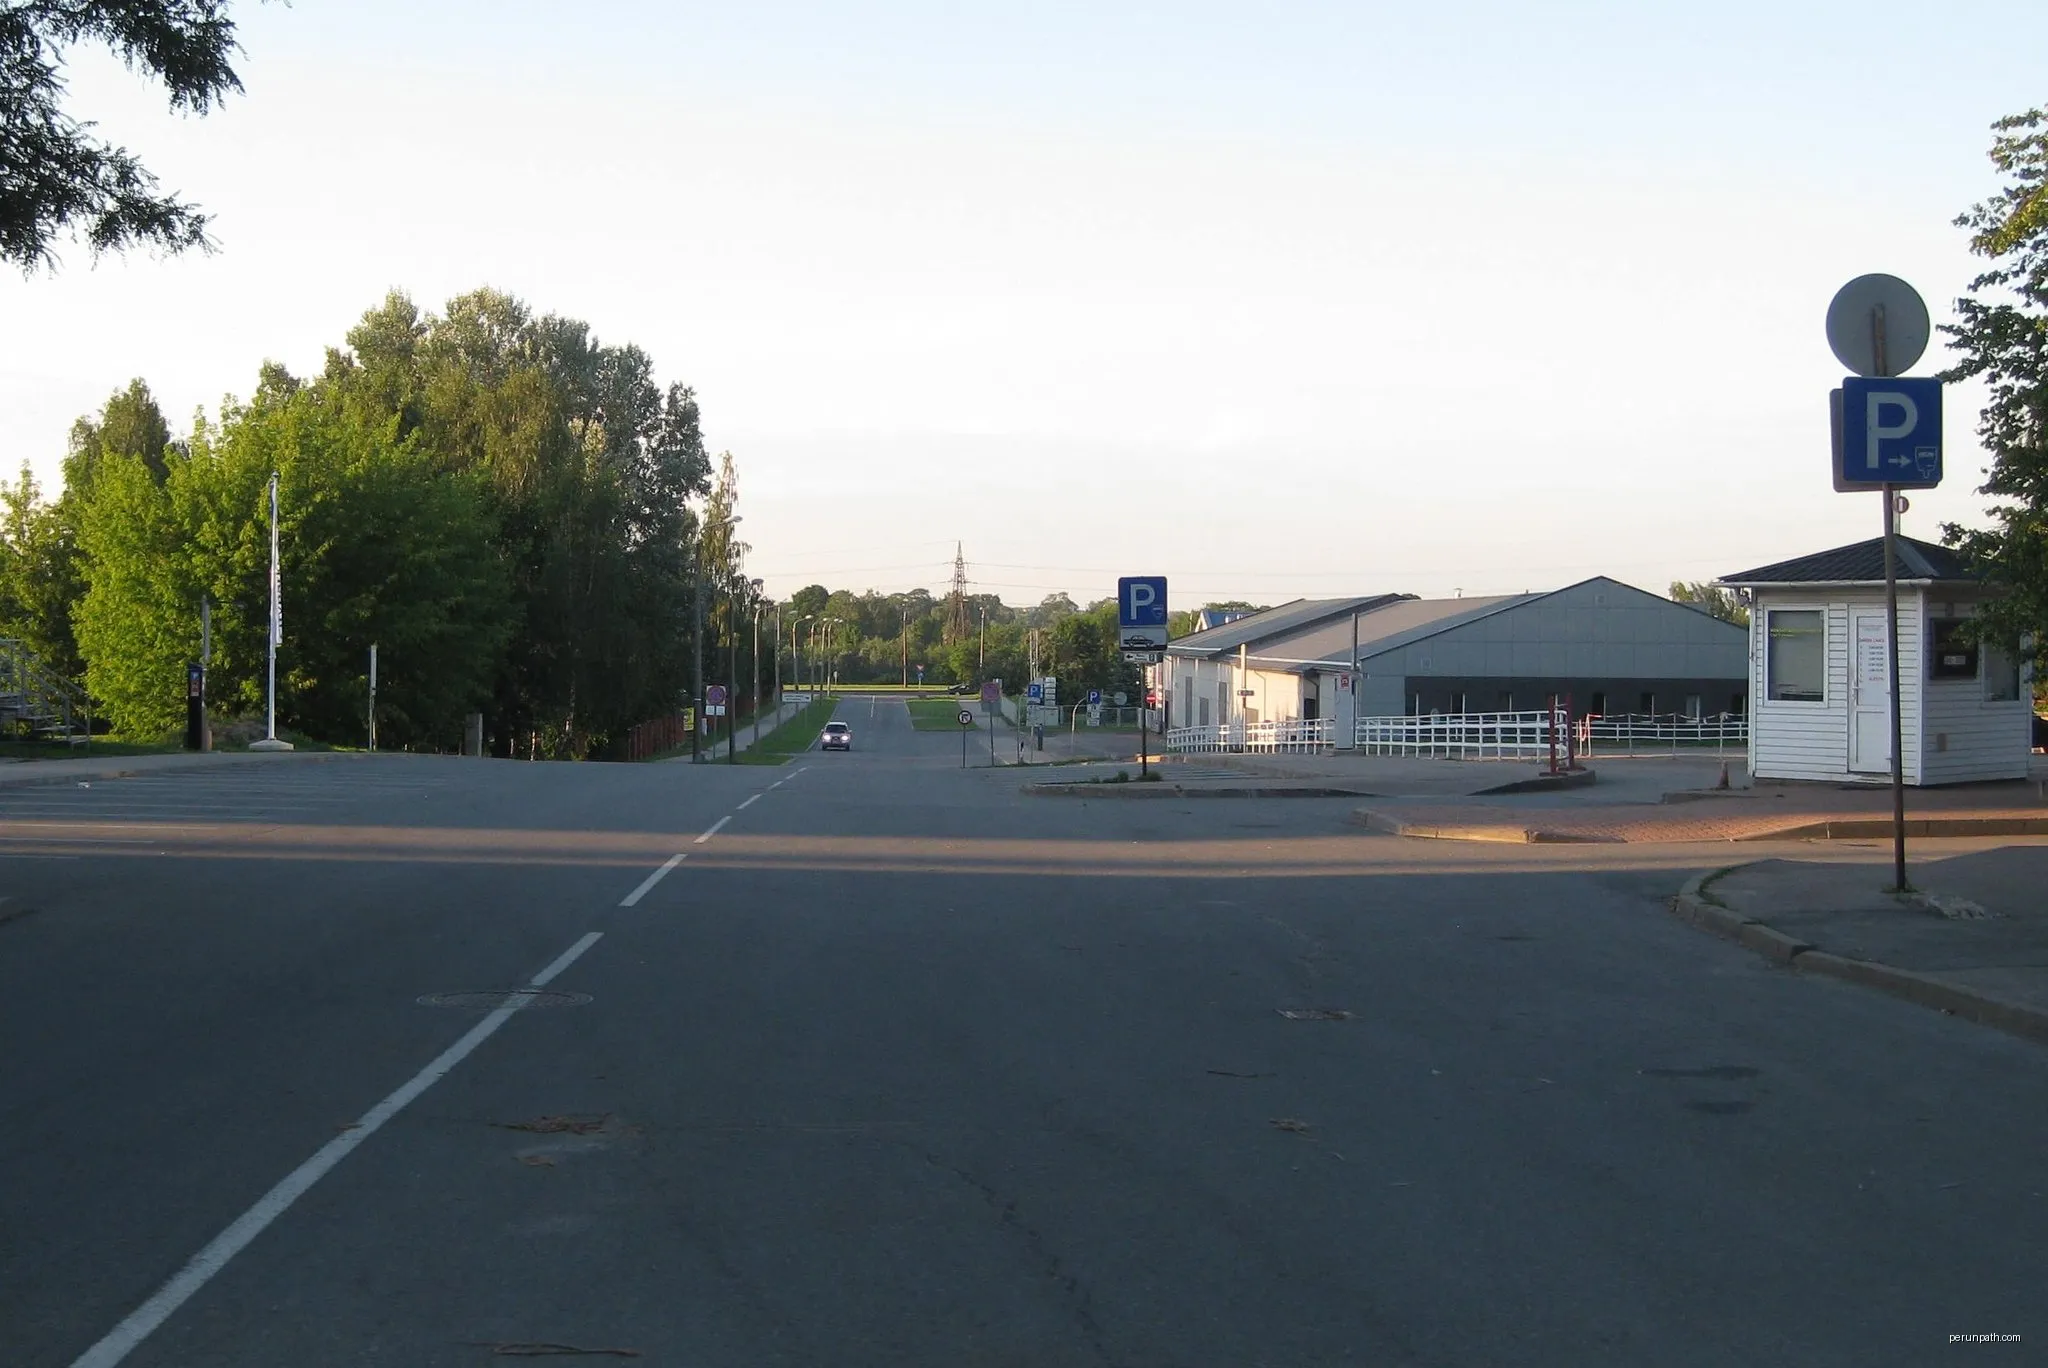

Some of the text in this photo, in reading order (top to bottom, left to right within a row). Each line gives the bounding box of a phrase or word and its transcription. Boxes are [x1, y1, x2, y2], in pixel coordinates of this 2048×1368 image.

[1866, 392, 1918, 469] P
[1130, 584, 1155, 620] P
[1030, 685, 1038, 696] P
[1090, 691, 1098, 702] P
